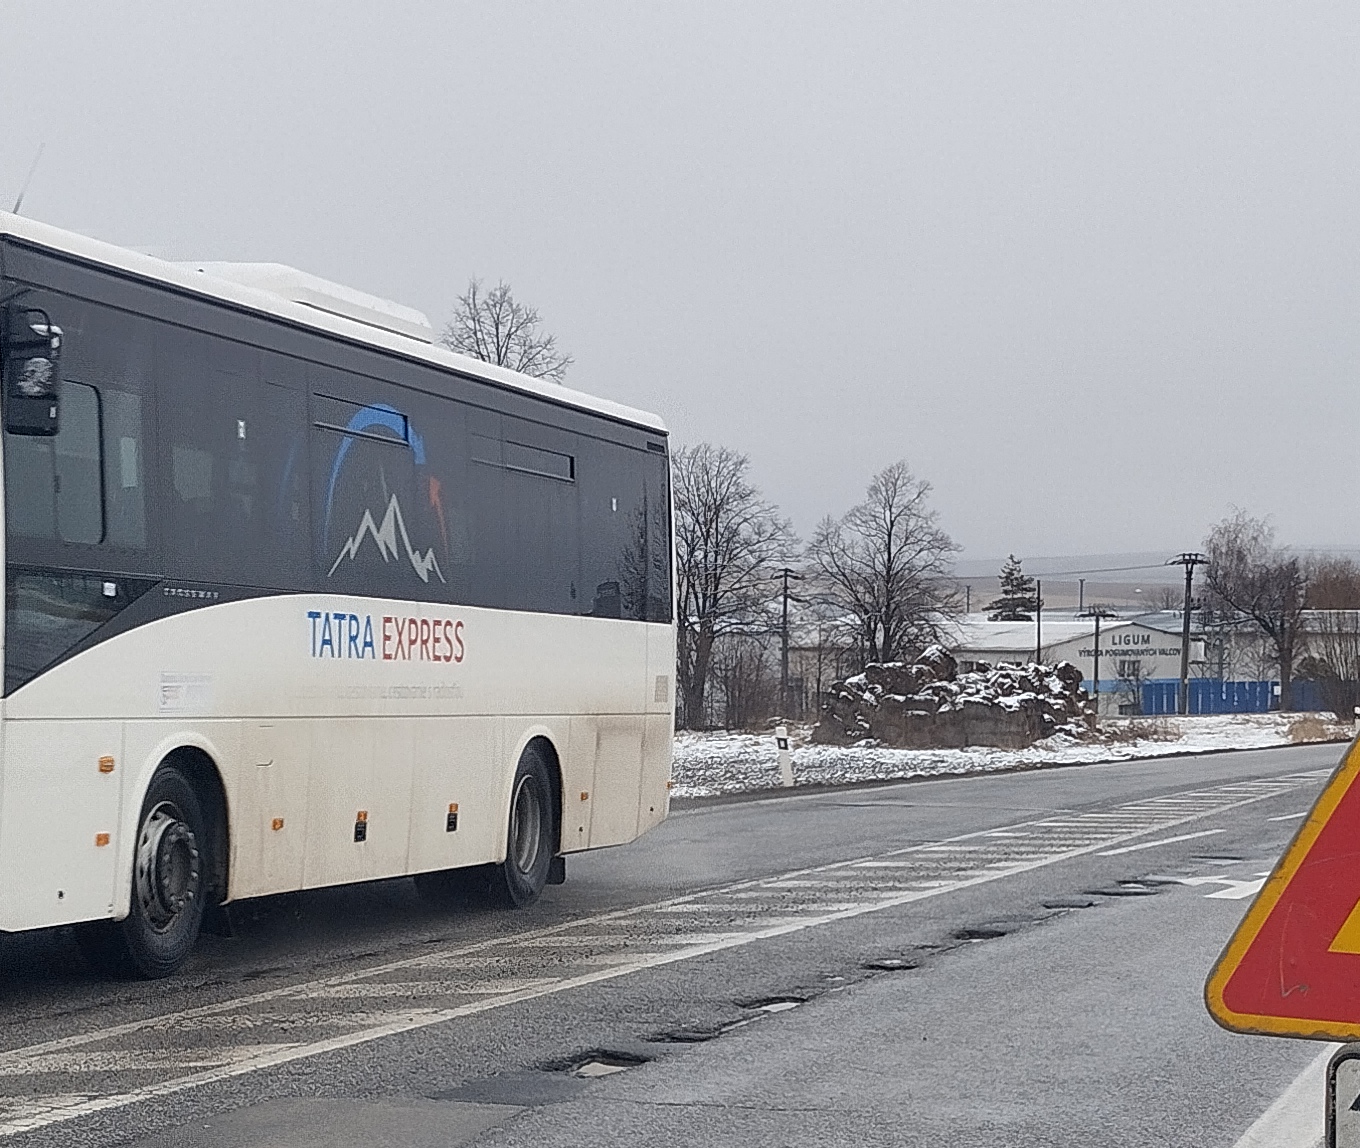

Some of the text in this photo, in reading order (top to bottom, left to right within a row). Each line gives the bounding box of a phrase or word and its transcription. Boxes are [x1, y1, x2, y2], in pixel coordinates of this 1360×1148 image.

[307, 611, 465, 663] TATRA EXPRESS
[1111, 634, 1150, 646] LIGUM
[1078, 646, 1103, 657] VÝROA
